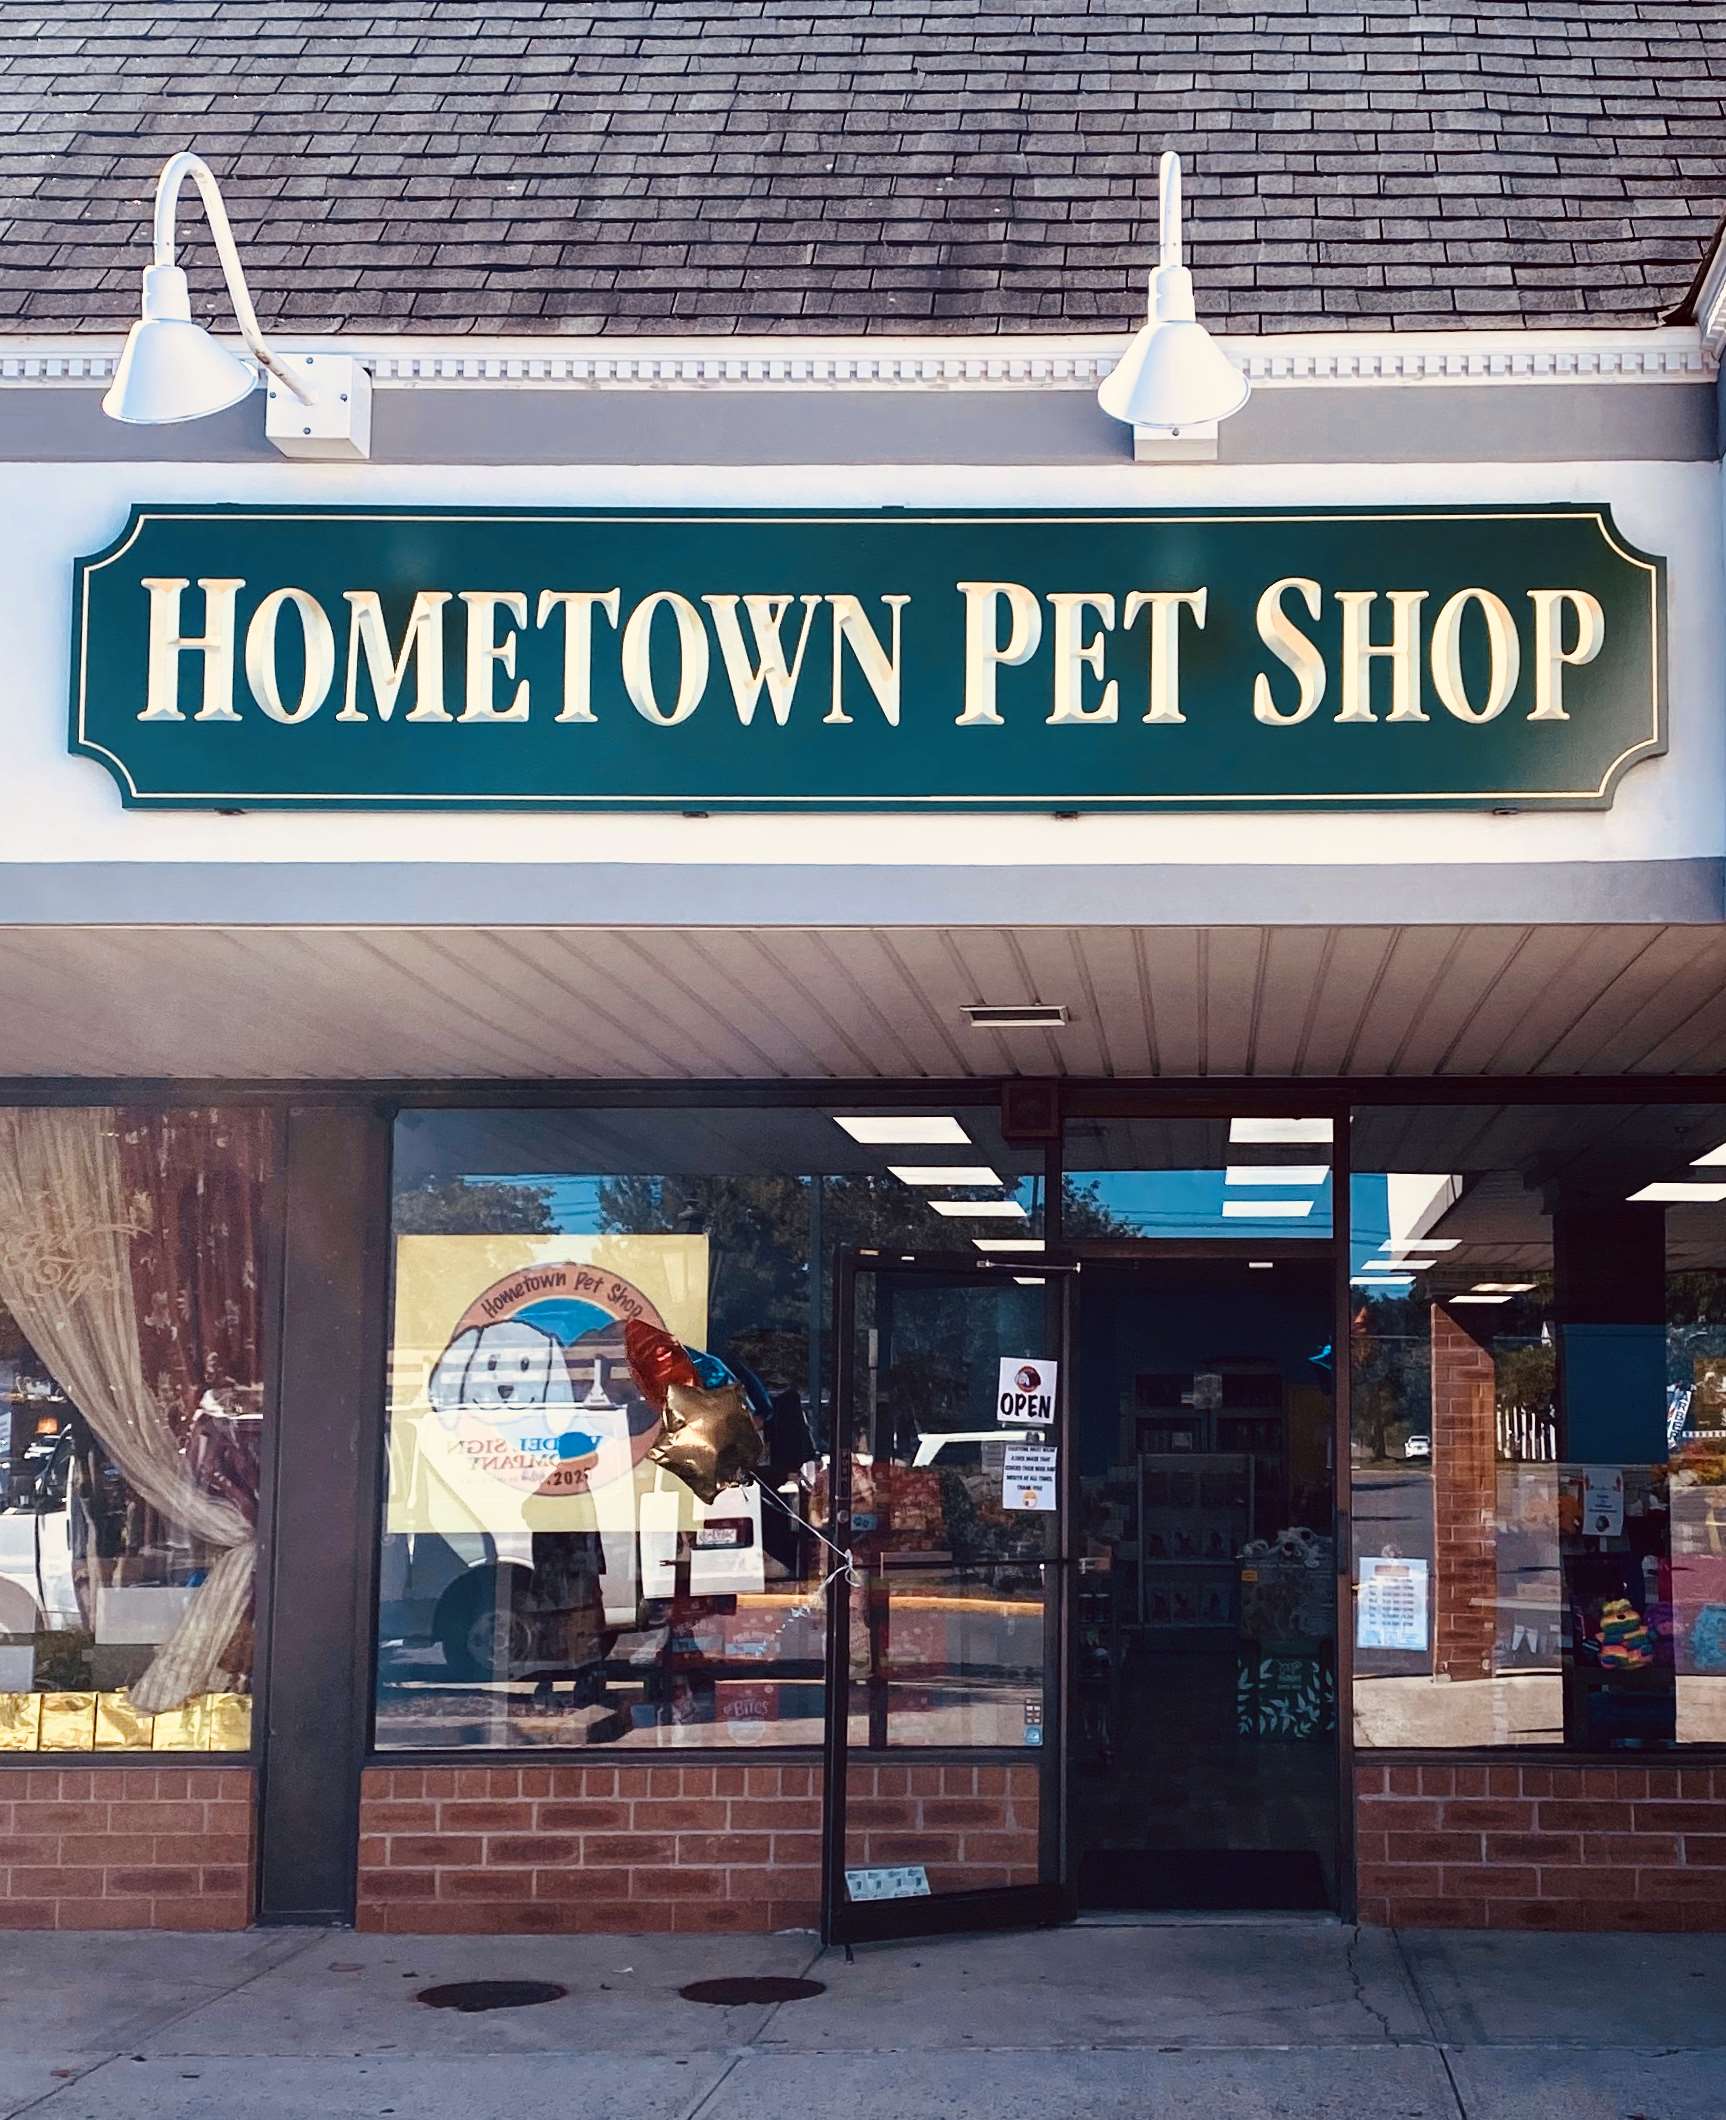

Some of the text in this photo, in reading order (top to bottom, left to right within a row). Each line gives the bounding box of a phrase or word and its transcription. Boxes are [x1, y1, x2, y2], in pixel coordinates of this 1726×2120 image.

[137, 576, 1606, 727] HOMETOWN PET SHOP
[481, 1271, 643, 1321] Hometown Pet Shop
[1000, 1392, 1051, 1419] OPEN
